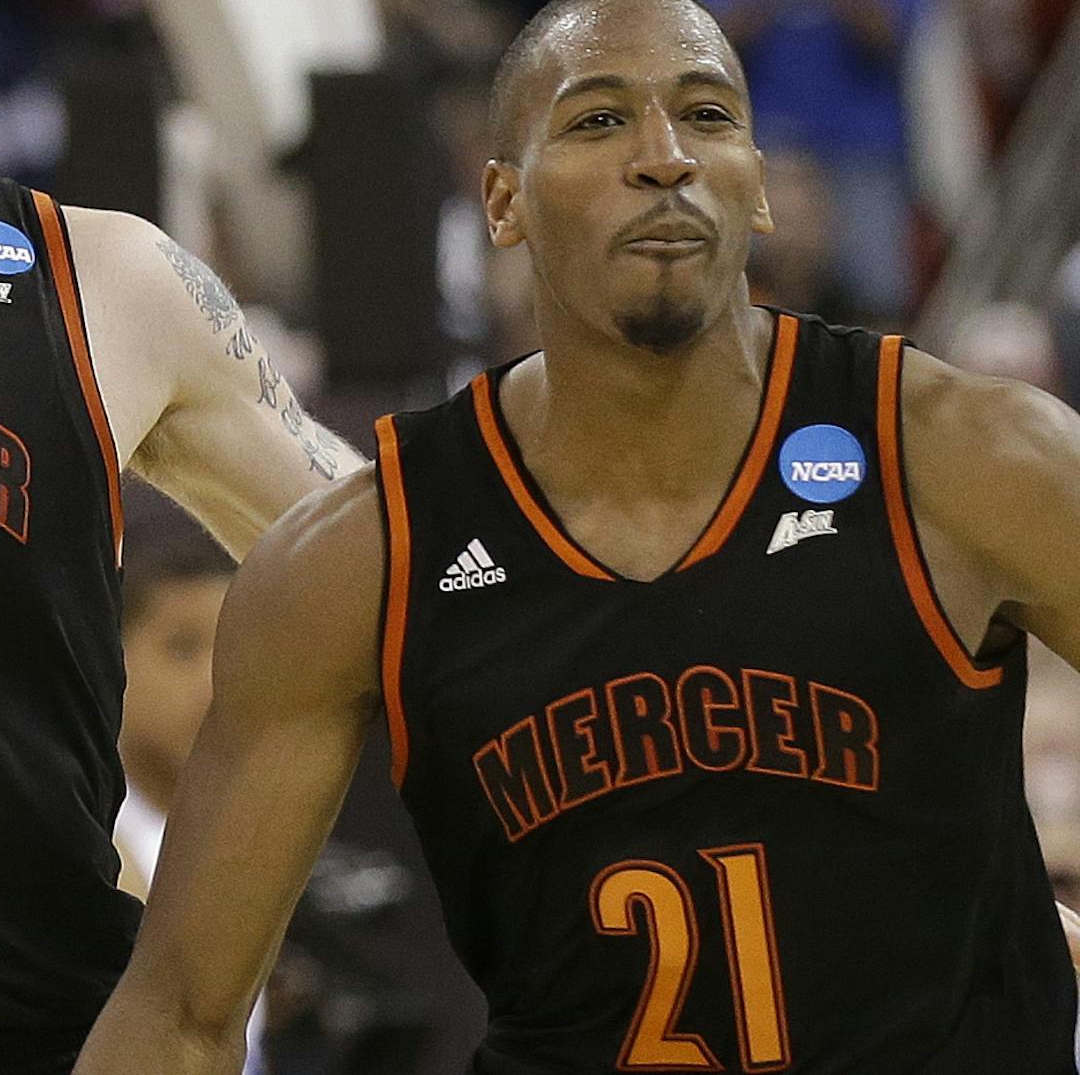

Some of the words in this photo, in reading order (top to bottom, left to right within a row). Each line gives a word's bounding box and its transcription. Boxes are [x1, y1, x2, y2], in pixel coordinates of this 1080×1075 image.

[791, 461, 861, 482] NCAA
[439, 567, 506, 592] adidas
[472, 665, 880, 843] MERCER
[588, 842, 791, 1073] 21
